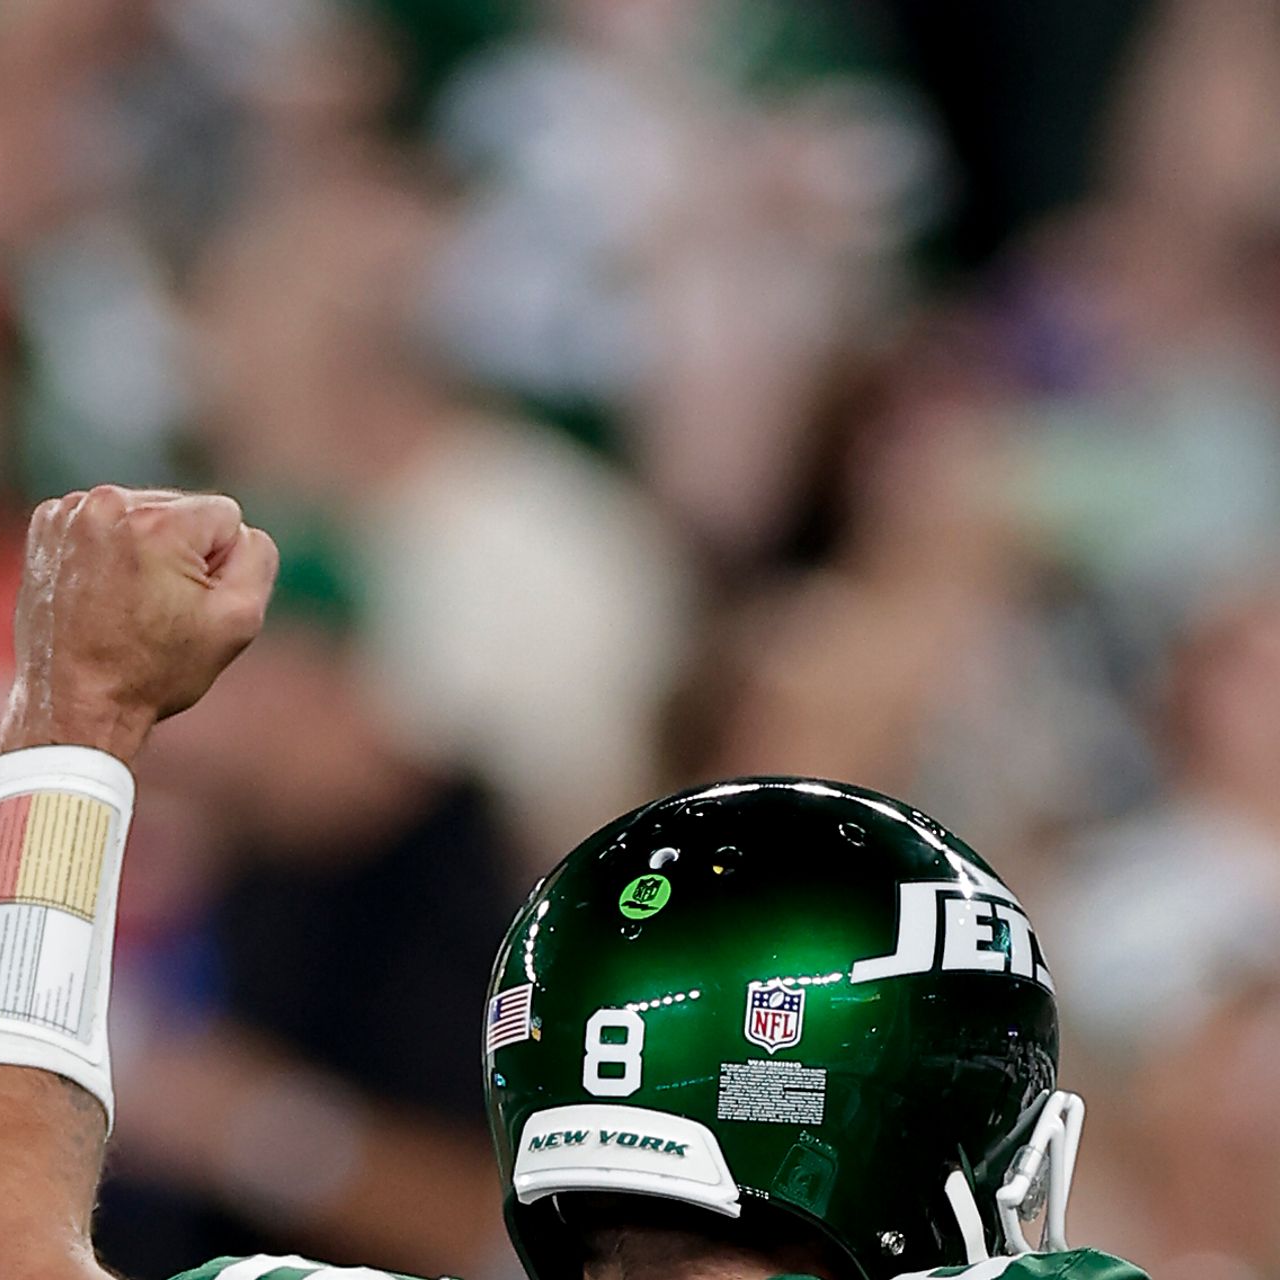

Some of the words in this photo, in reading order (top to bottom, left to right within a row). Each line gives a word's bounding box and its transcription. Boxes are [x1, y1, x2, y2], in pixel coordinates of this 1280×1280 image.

[753, 1010, 794, 1041] NFL
[583, 1009, 645, 1097] 8
[748, 1059, 802, 1069] WARNING
[528, 1130, 589, 1152] NEW
[599, 1130, 690, 1157] YORK
